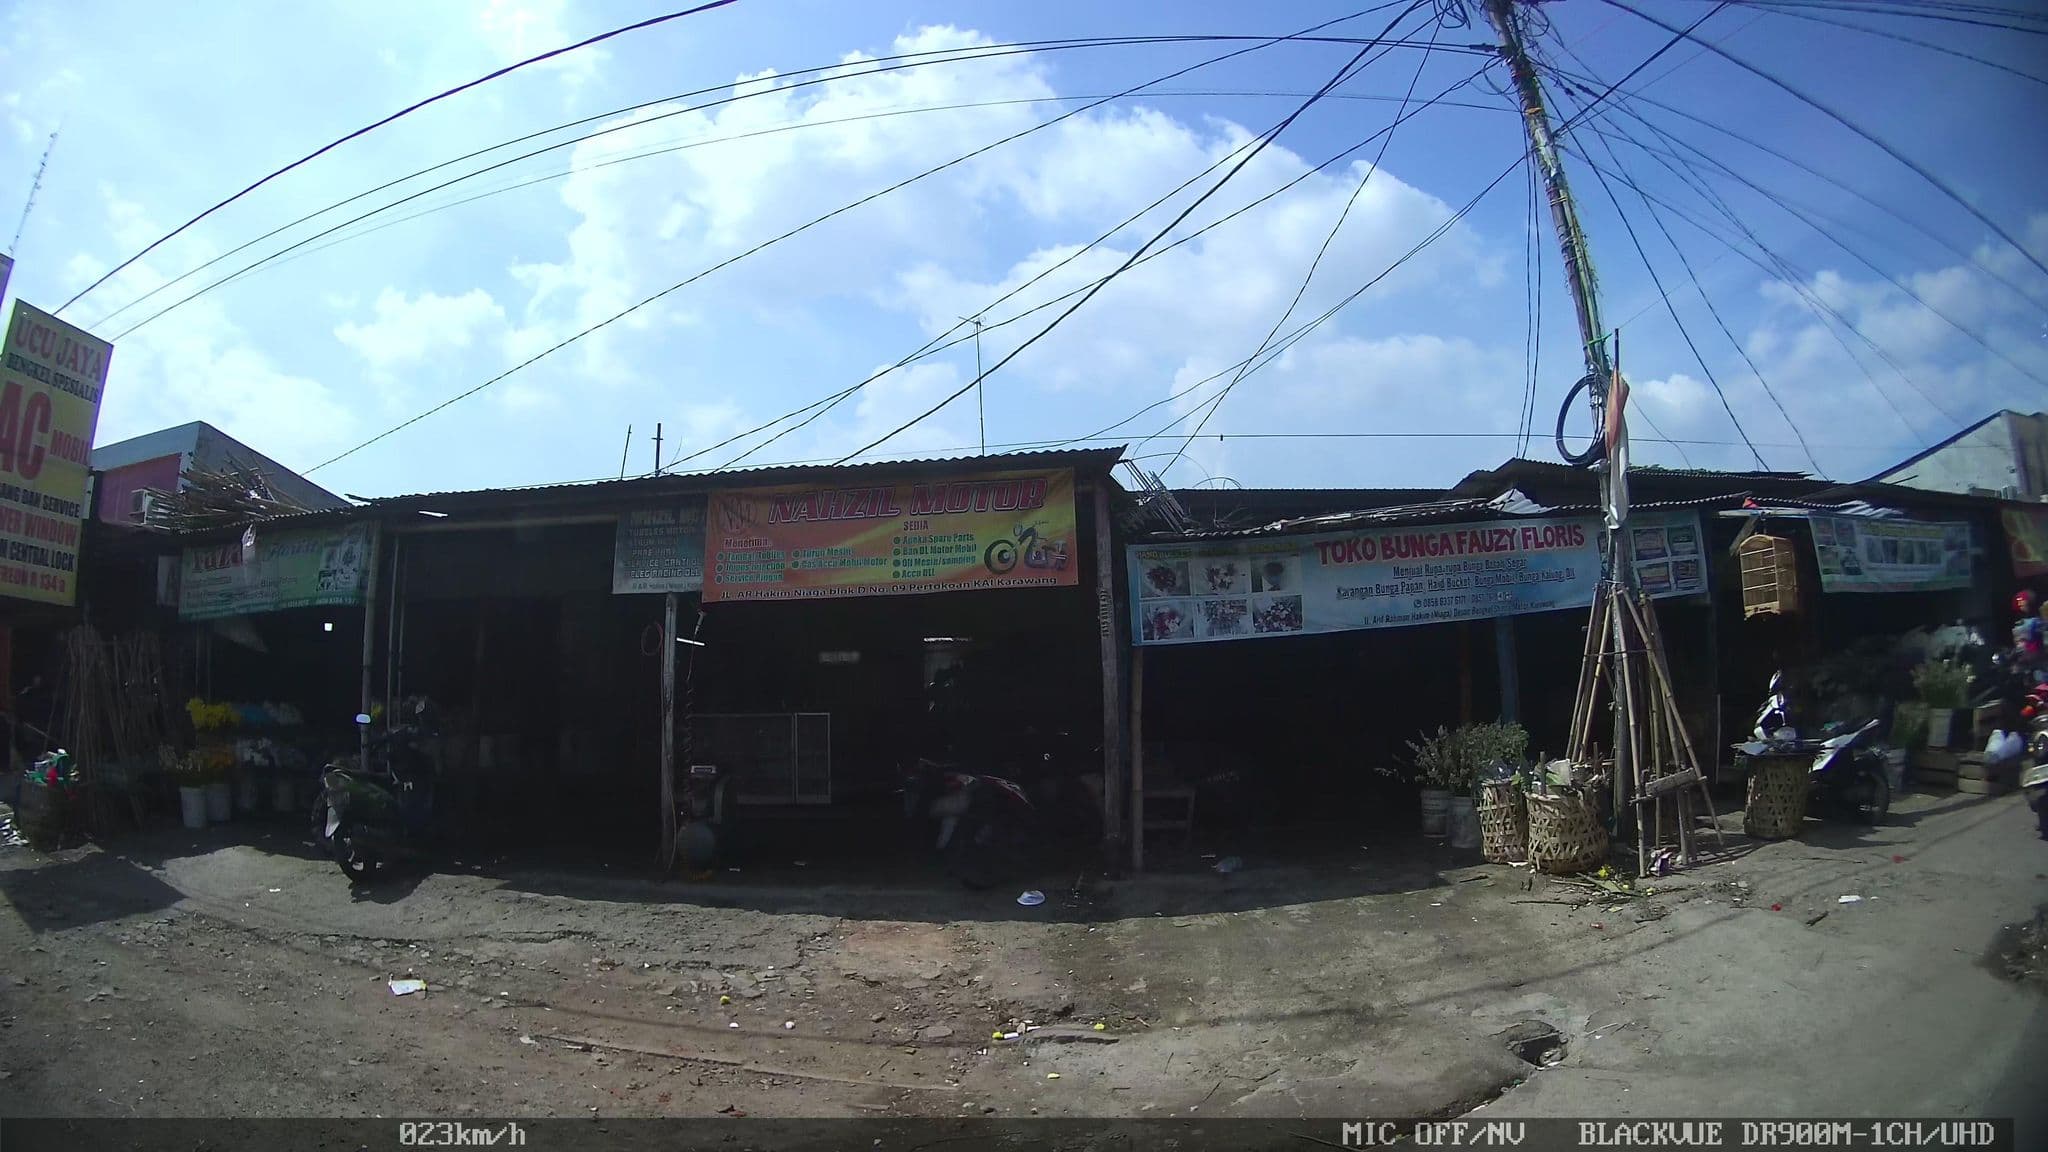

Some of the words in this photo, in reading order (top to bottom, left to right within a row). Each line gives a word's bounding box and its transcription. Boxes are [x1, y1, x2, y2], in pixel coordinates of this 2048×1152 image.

[15, 317, 57, 359] UCU
[56, 337, 102, 381] JAYA
[0, 380, 52, 481] AC
[50, 429, 91, 466] MOBIL
[43, 494, 80, 519] SERVICE
[768, 487, 901, 524] NAHZIL
[911, 477, 1048, 516] MOTOR
[25, 512, 77, 547] WINDOW
[904, 520, 929, 531] SEDIA
[953, 533, 975, 543] Parts
[10, 541, 48, 567] CENTRAL
[51, 550, 75, 572] LOCK
[1314, 537, 1377, 565] TOKO
[1380, 533, 1454, 561] BUNGA
[1456, 527, 1517, 555] FAUZY
[1521, 524, 1585, 550] FLORIS
[755, 589, 791, 598] Hakim
[794, 588, 827, 598] Niaga
[859, 586, 866, 594] D
[910, 581, 969, 591] Pertokoan
[974, 579, 994, 588] KAI
[997, 577, 1057, 588] Karawang
[1375, 583, 1399, 597] Bunga
